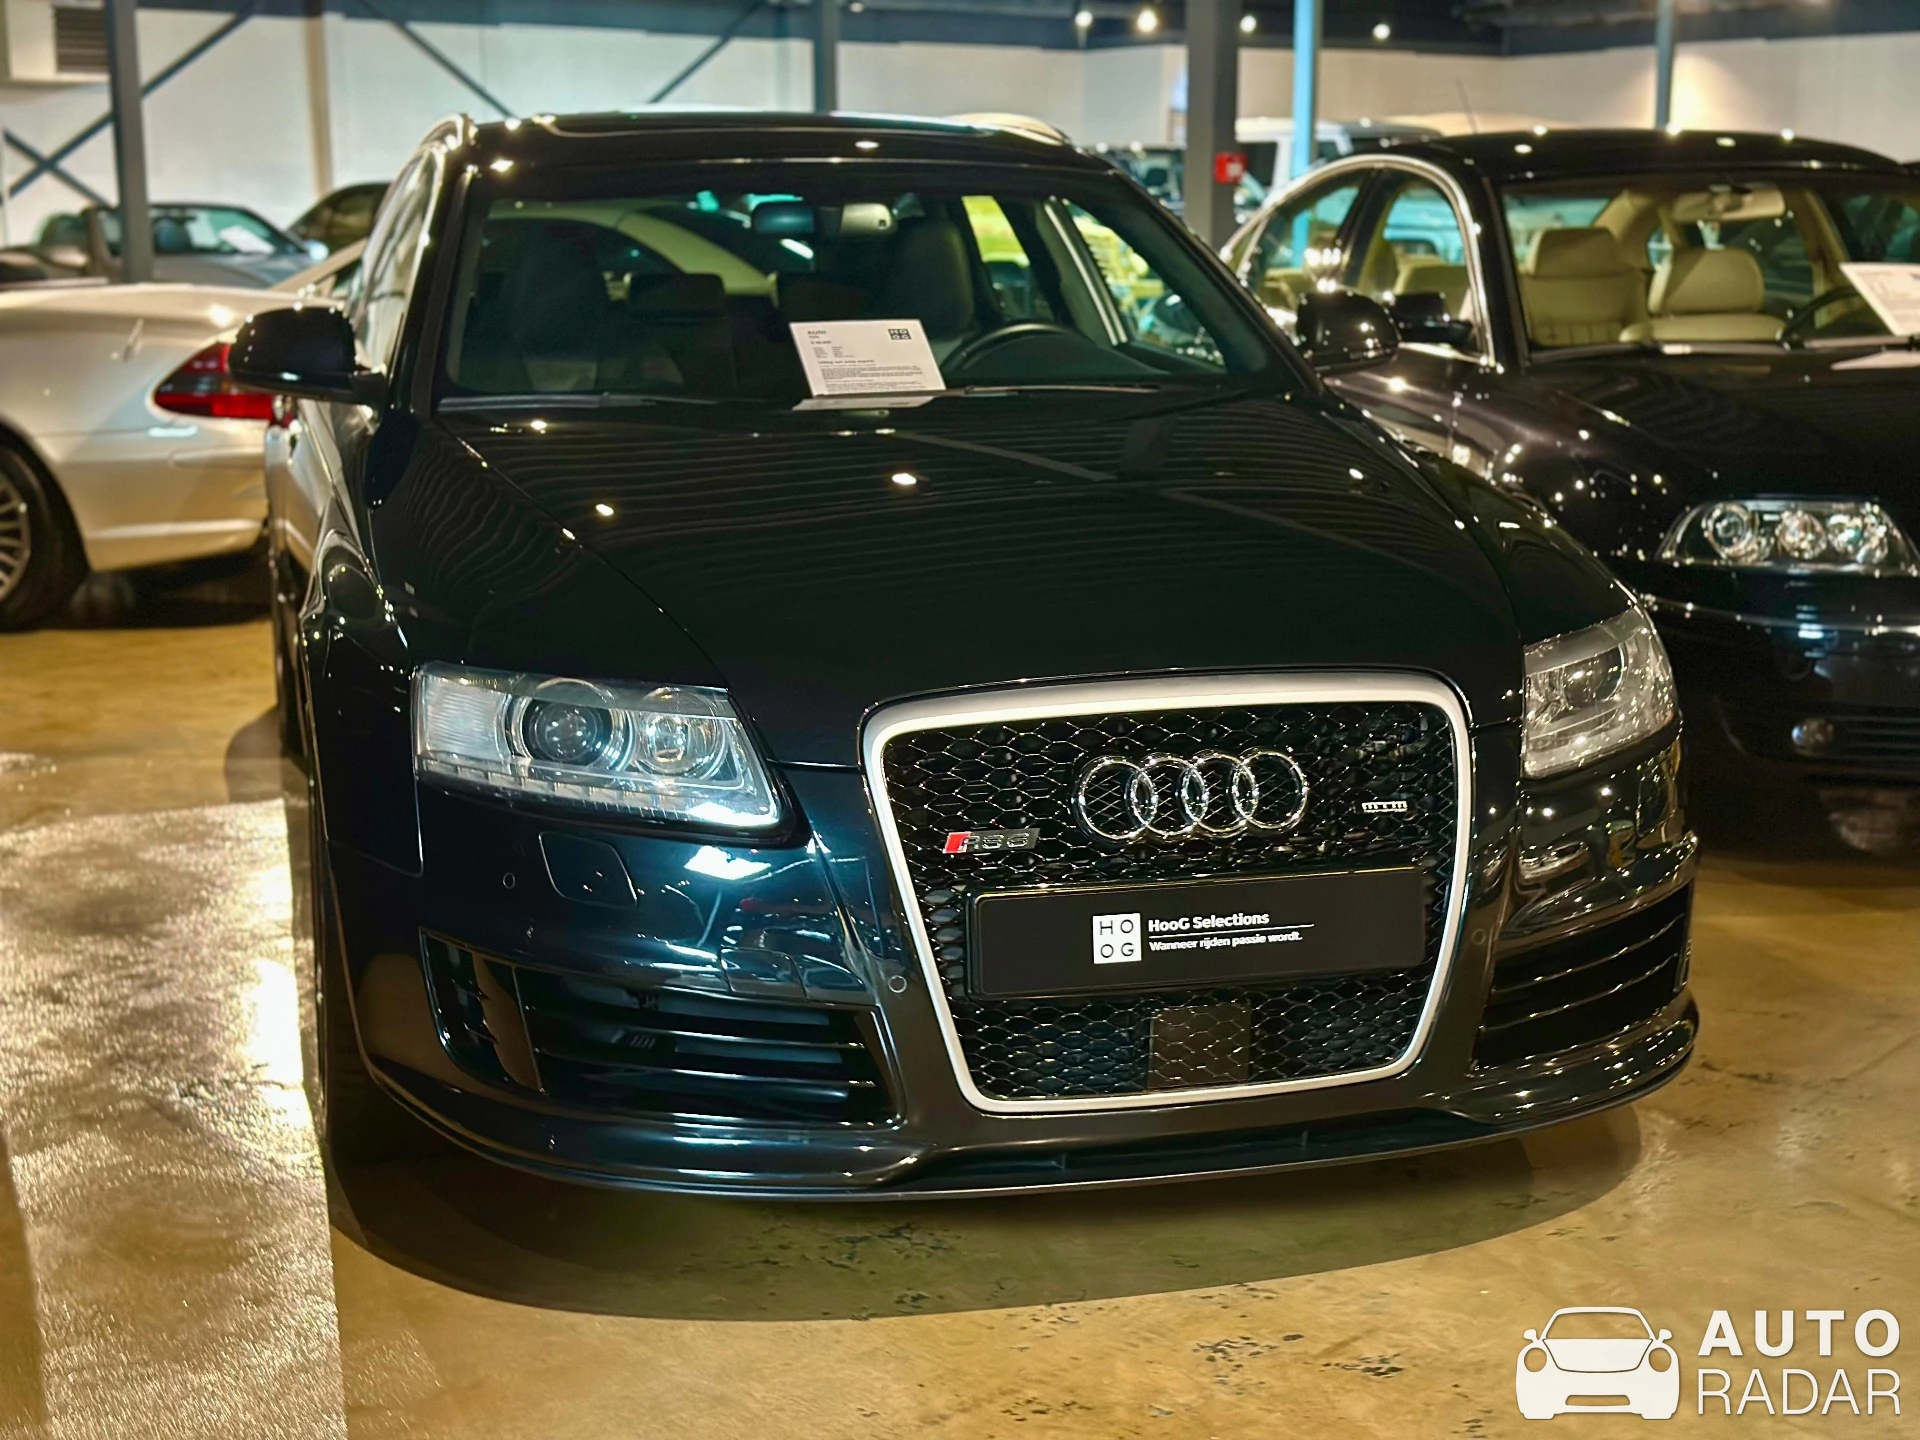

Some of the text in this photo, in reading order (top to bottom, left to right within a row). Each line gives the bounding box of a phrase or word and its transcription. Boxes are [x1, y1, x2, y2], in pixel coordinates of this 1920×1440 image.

[956, 832, 1031, 852] RS6
[1148, 913, 1270, 932] HooG Selections
[1149, 931, 1303, 951] Wanneer rijden passie wordt.
